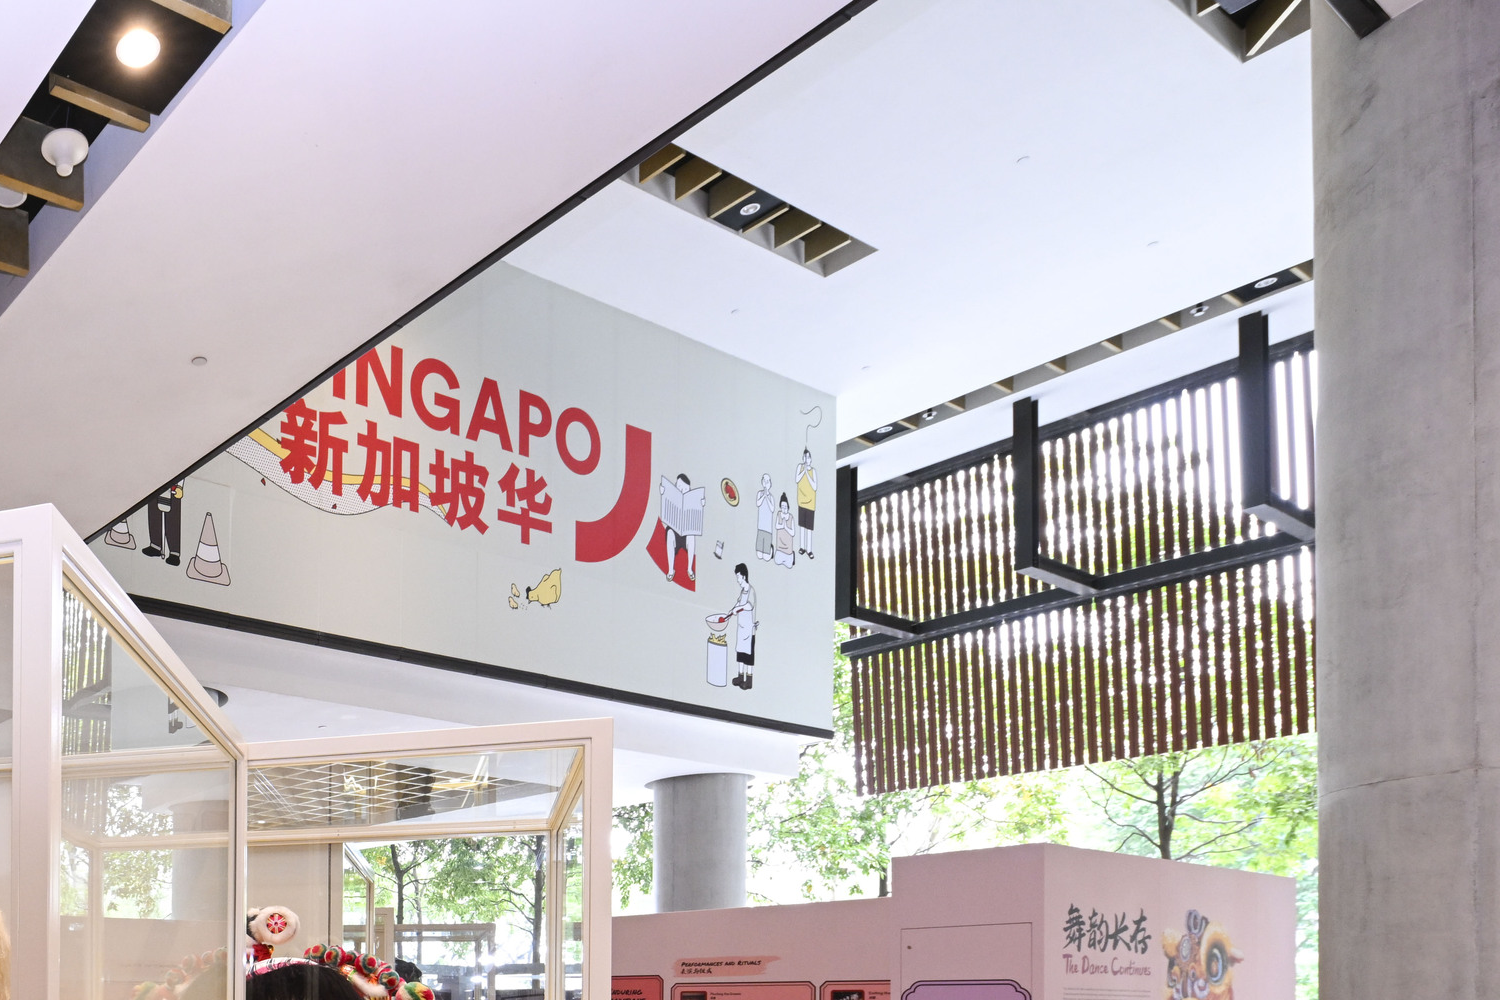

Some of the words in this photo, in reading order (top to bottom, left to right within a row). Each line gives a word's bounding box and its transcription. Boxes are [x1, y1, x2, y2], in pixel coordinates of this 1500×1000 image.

[1063, 903, 1152, 954] 舞韵长存
[1063, 954, 1078, 975] The
[1082, 955, 1109, 975] Dance
[1111, 957, 1151, 976] Continues
